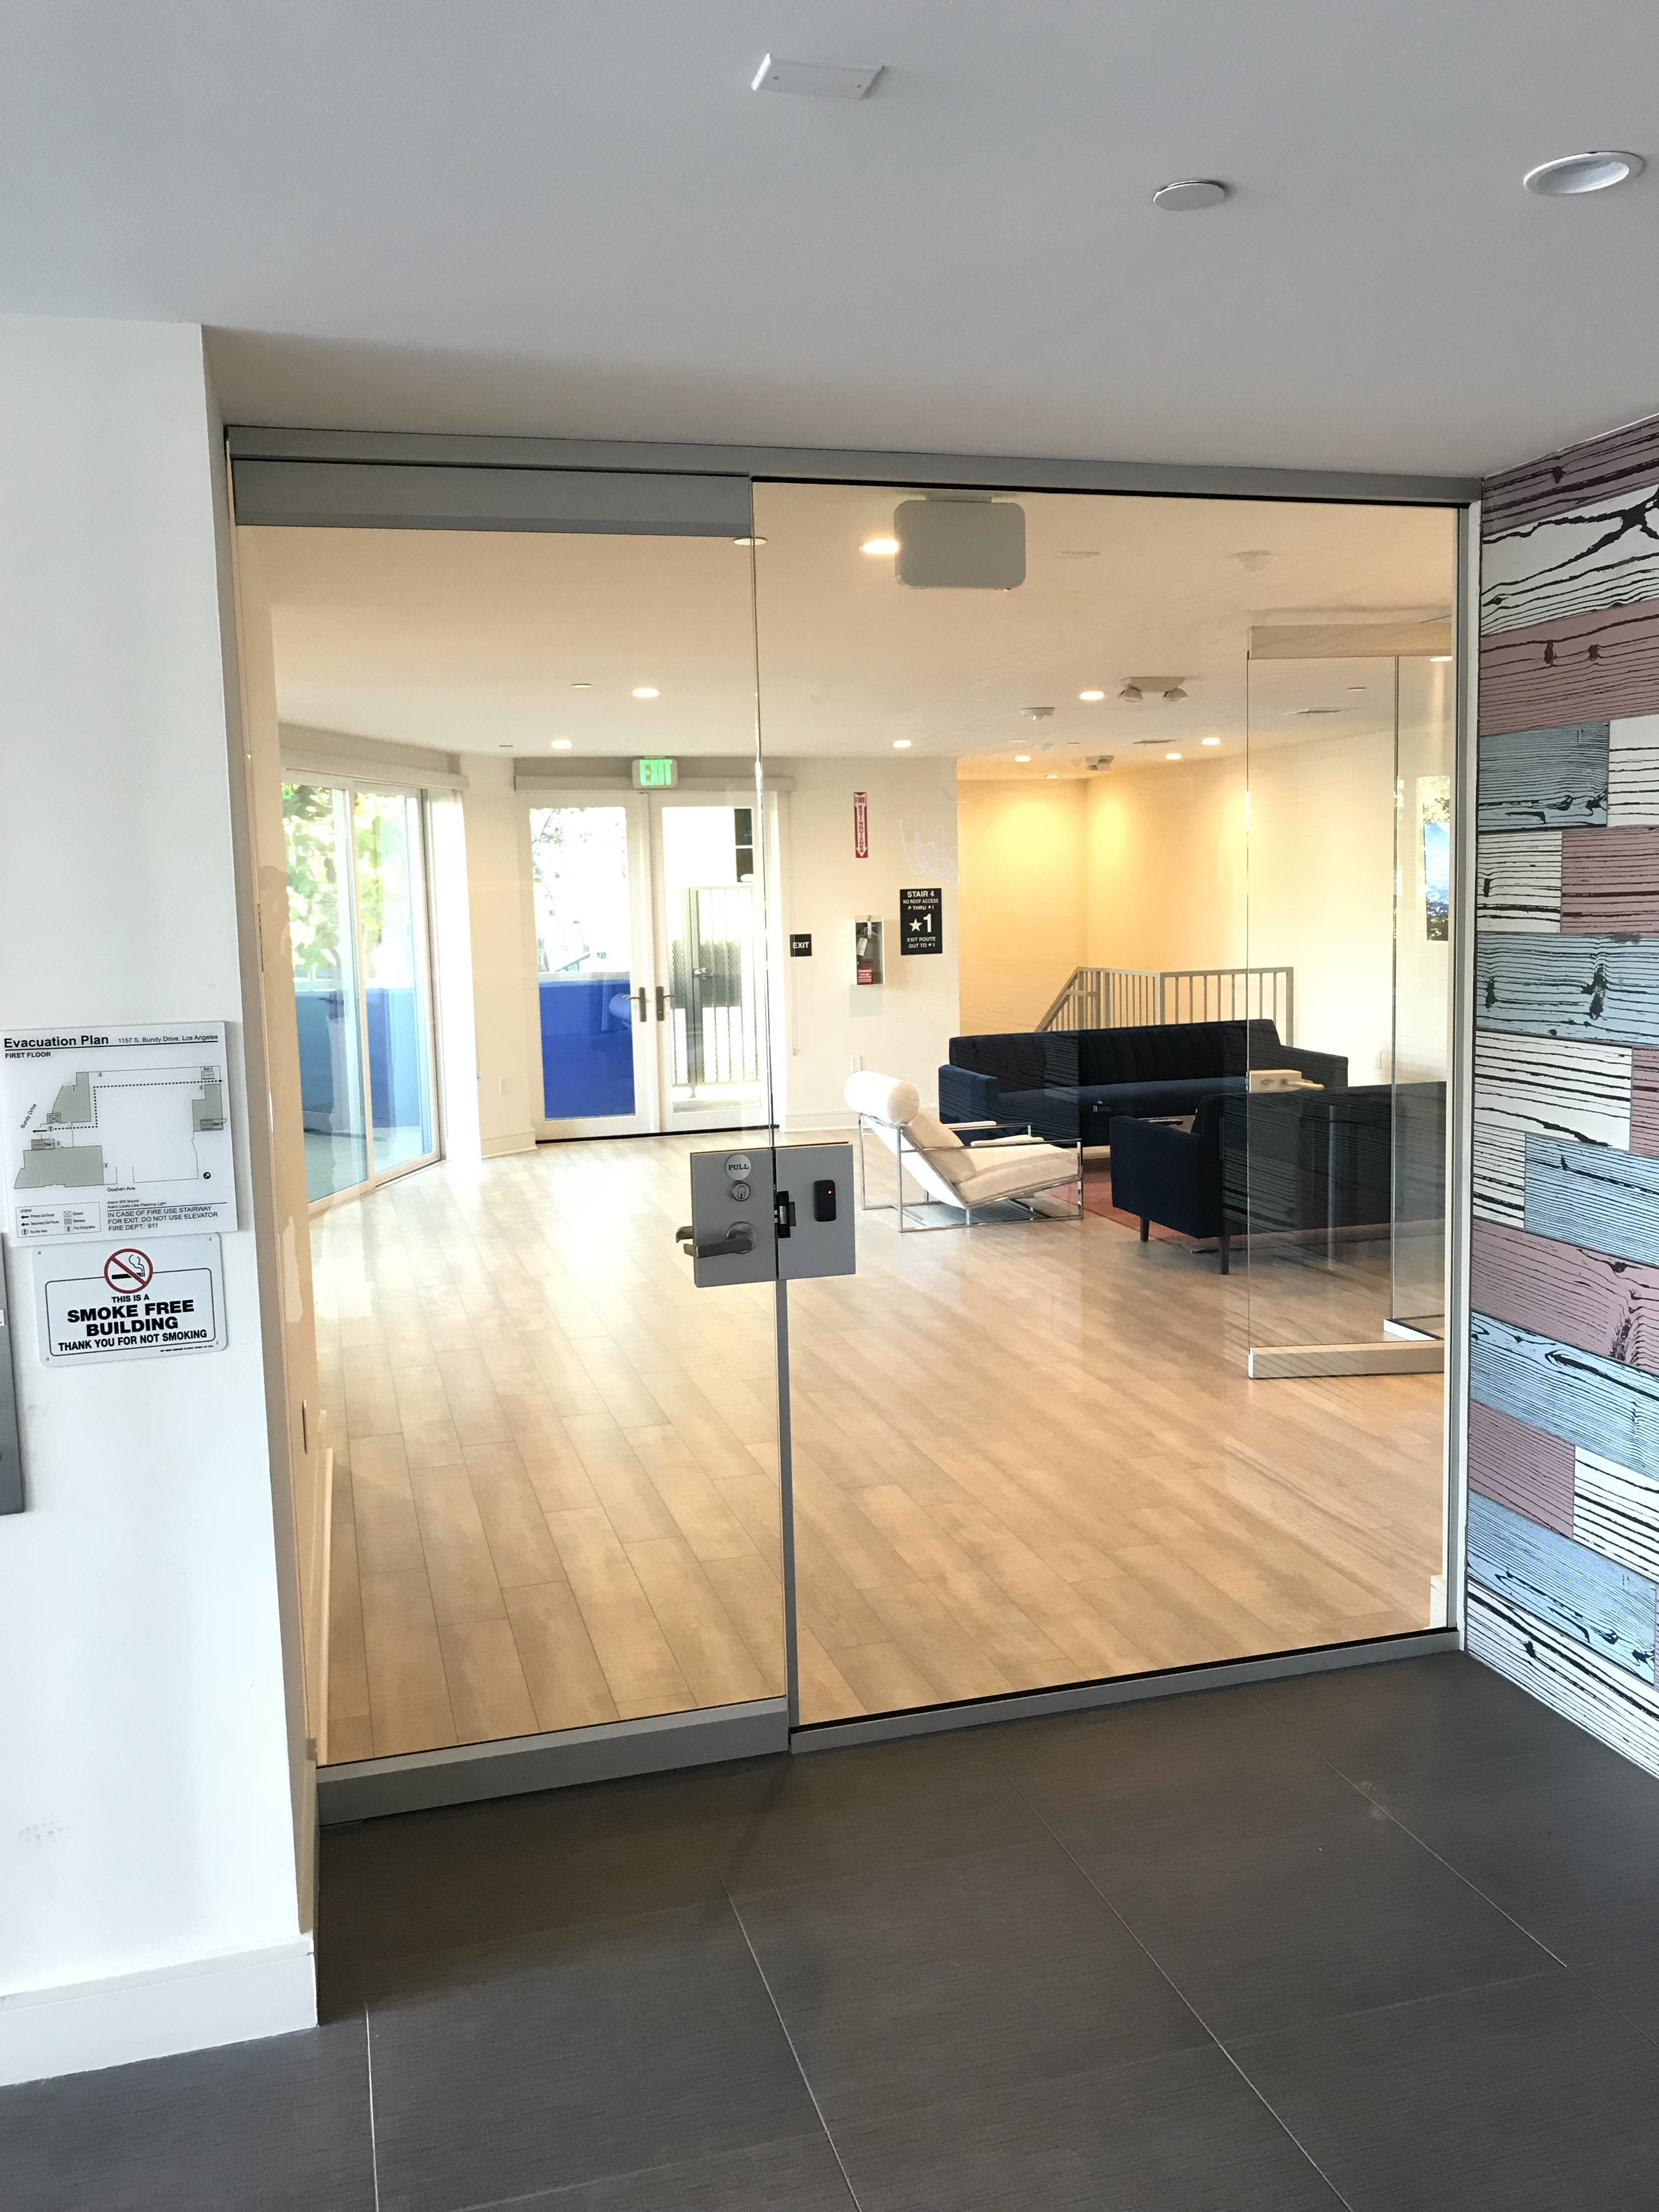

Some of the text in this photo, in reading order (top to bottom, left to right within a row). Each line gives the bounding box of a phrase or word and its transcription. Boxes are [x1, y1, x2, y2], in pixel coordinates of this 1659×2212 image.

[639, 759, 673, 786] EXIT
[4, 1035, 109, 1048] Evacuation Plan
[27, 1104, 37, 1115] Drive
[111, 1295, 131, 1303] THIS
[67, 1299, 195, 1323] SMOKE FREE
[86, 1316, 179, 1336] BUILDING
[58, 1329, 207, 1351] THANK YOU FOR NOT SMOKING
